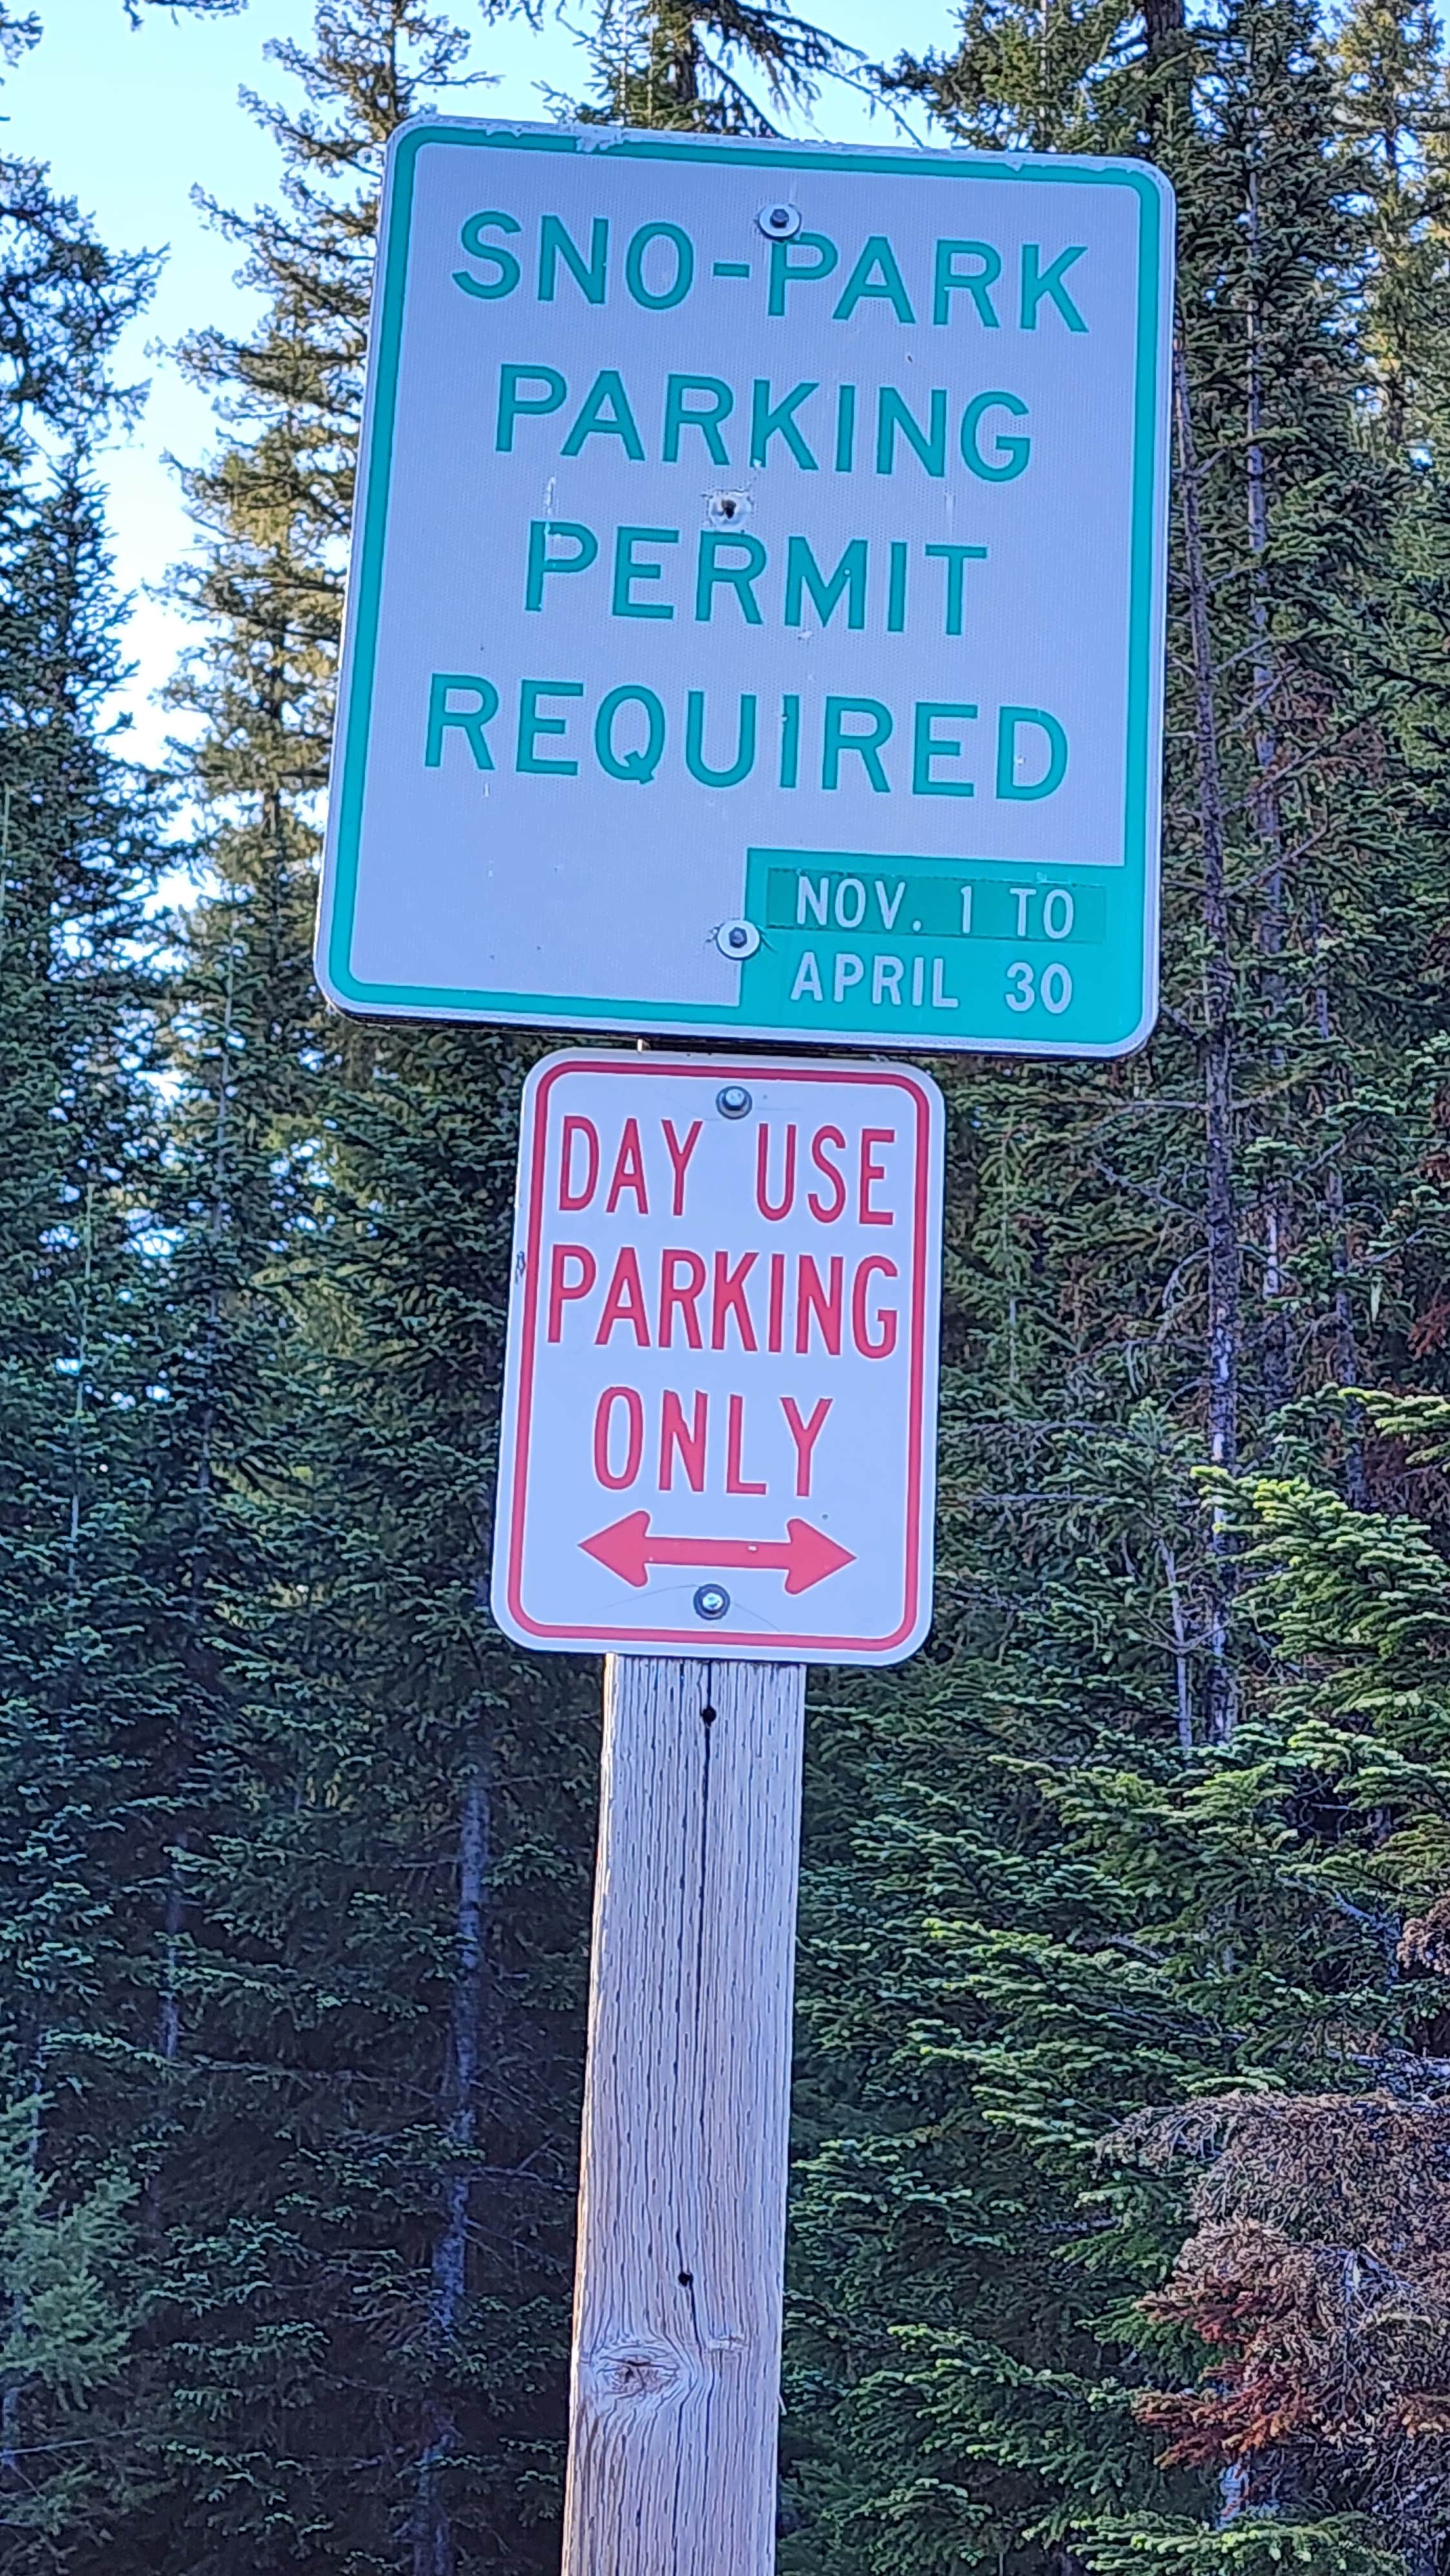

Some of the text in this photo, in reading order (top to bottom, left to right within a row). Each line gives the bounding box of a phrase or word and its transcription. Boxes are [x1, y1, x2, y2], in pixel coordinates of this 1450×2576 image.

[450, 208, 1089, 335] SNO-PARK
[493, 361, 1033, 485] PARKING
[523, 518, 990, 638] PERMIT
[422, 671, 1070, 803] REQUIRED
[797, 876, 1073, 939] NOV. 1 TO
[791, 952, 1072, 1014] APRIL 30
[560, 1115, 896, 1226] DAY USE
[547, 1244, 898, 1359] PARKING
[594, 1386, 834, 1498] ONLY
